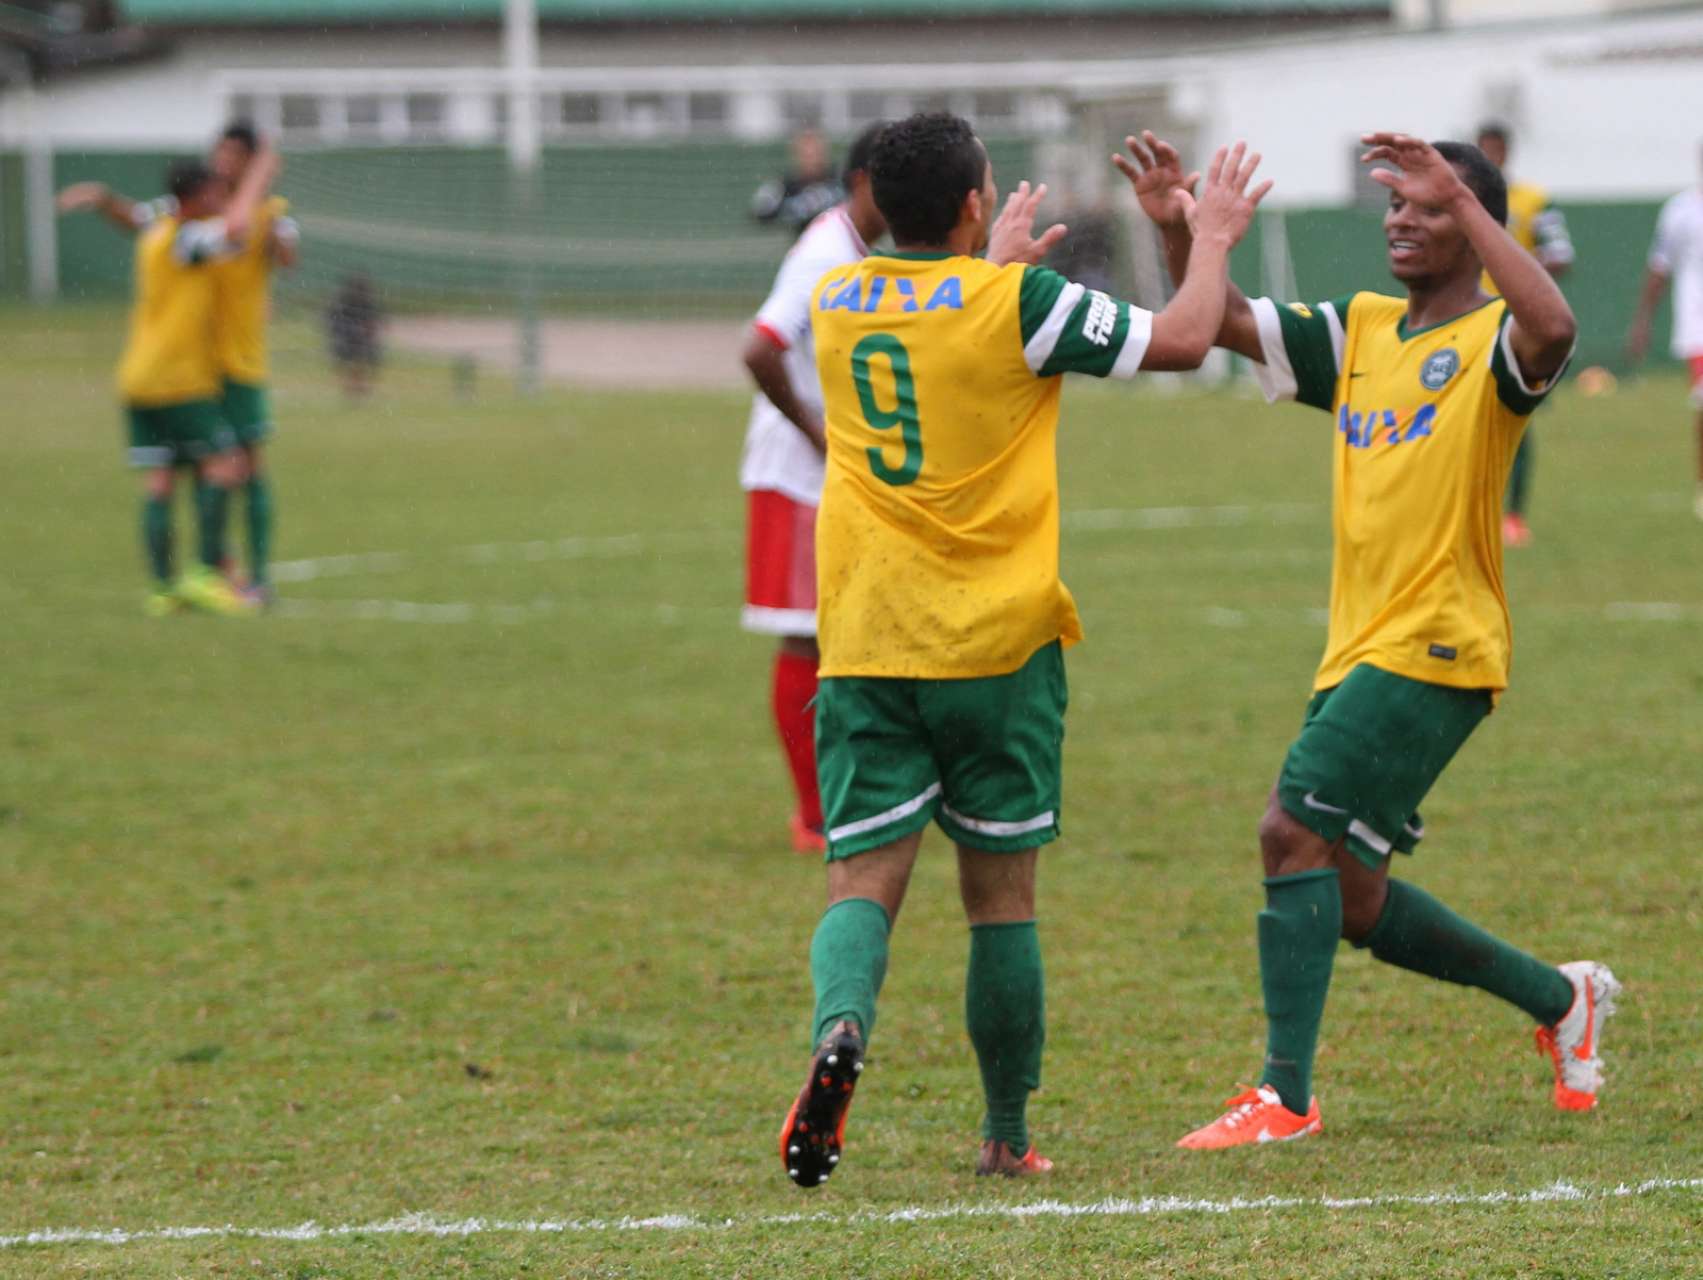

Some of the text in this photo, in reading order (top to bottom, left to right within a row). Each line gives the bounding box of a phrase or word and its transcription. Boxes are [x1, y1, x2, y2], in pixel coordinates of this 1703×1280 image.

[819, 276, 964, 313] CAIXA
[1081, 292, 1107, 343] PRO
[851, 332, 924, 486] 9
[1339, 403, 1437, 448] AIXA
